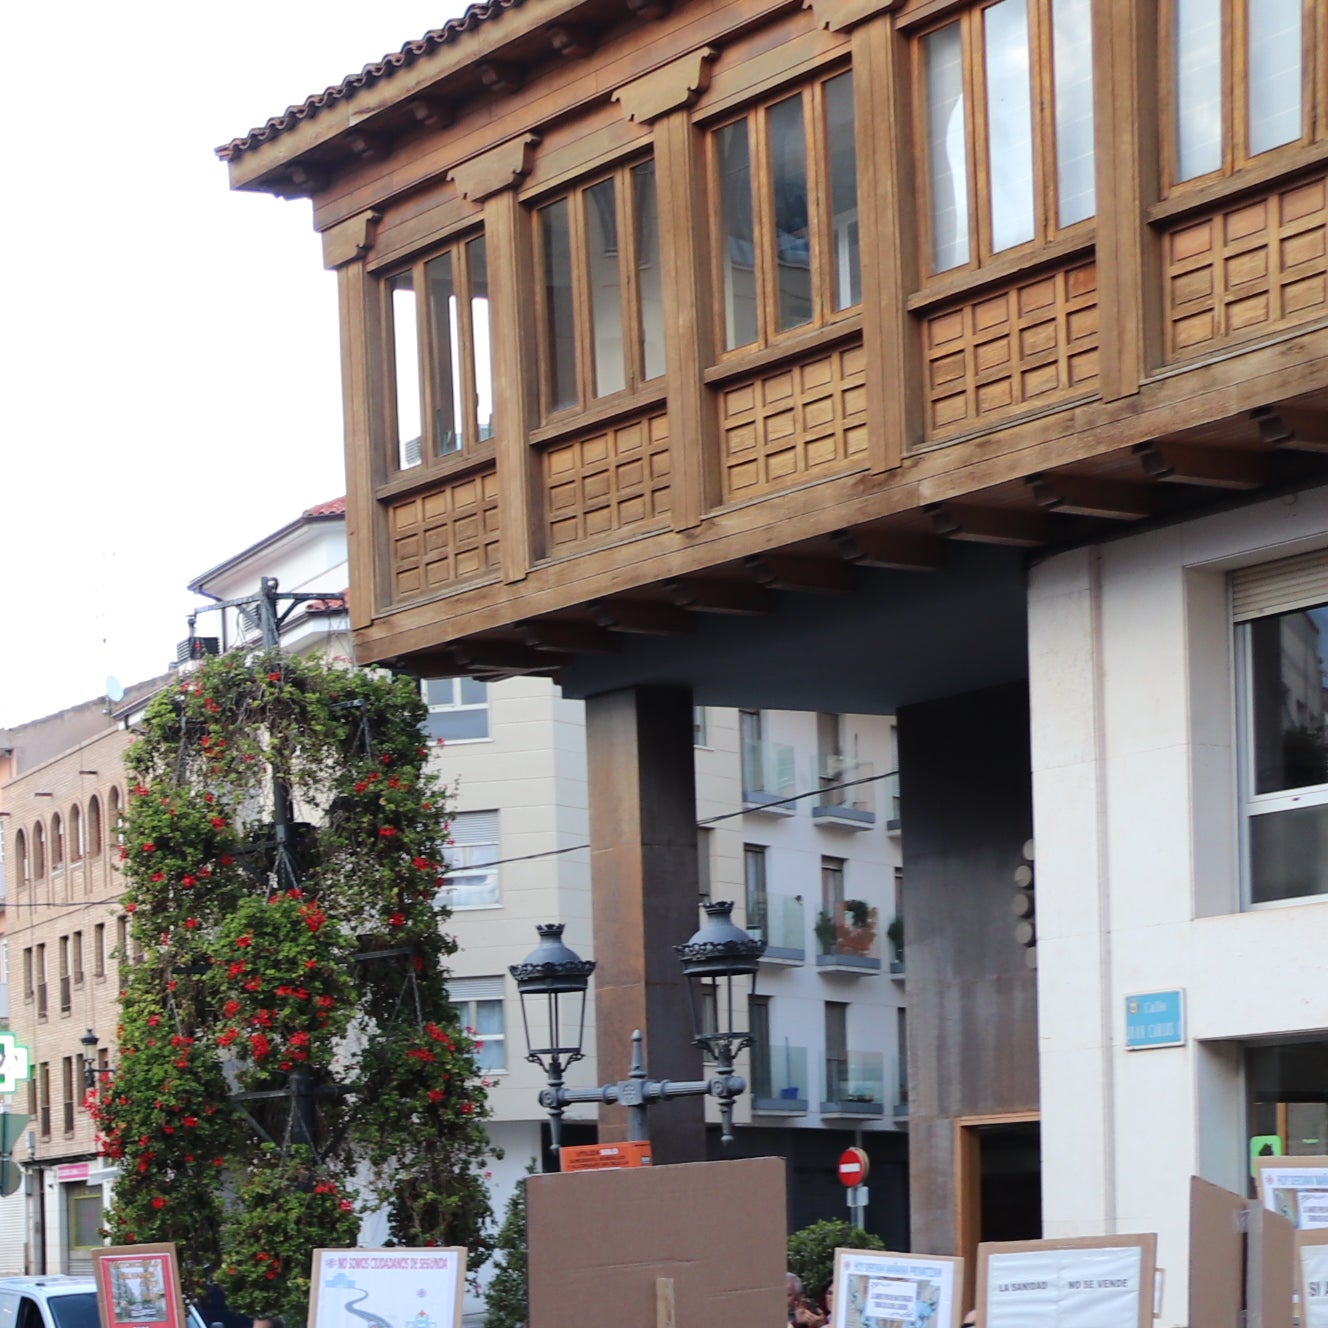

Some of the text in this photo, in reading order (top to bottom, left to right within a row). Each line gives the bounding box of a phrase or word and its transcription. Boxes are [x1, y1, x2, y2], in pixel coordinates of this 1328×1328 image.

[338, 1258, 448, 1269] NO SOMOS CIUDADANOS DE SEGUNDA
[999, 1278, 1128, 1292] LA SANIDAD NO SE VENDE
